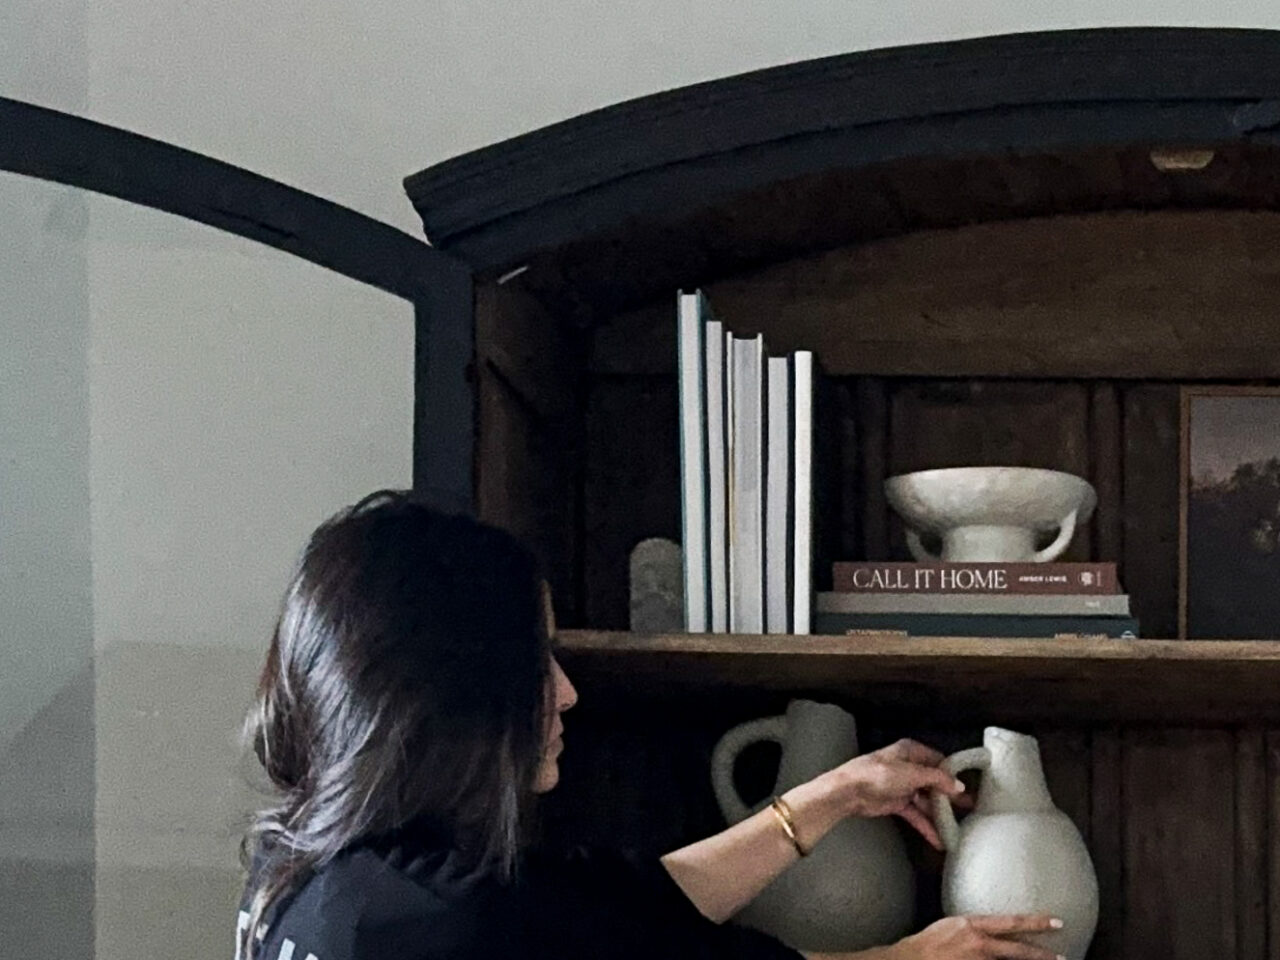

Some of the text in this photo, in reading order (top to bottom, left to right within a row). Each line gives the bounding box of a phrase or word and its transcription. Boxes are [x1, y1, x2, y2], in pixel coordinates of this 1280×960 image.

[853, 568, 1008, 590] CALL IT HOME
